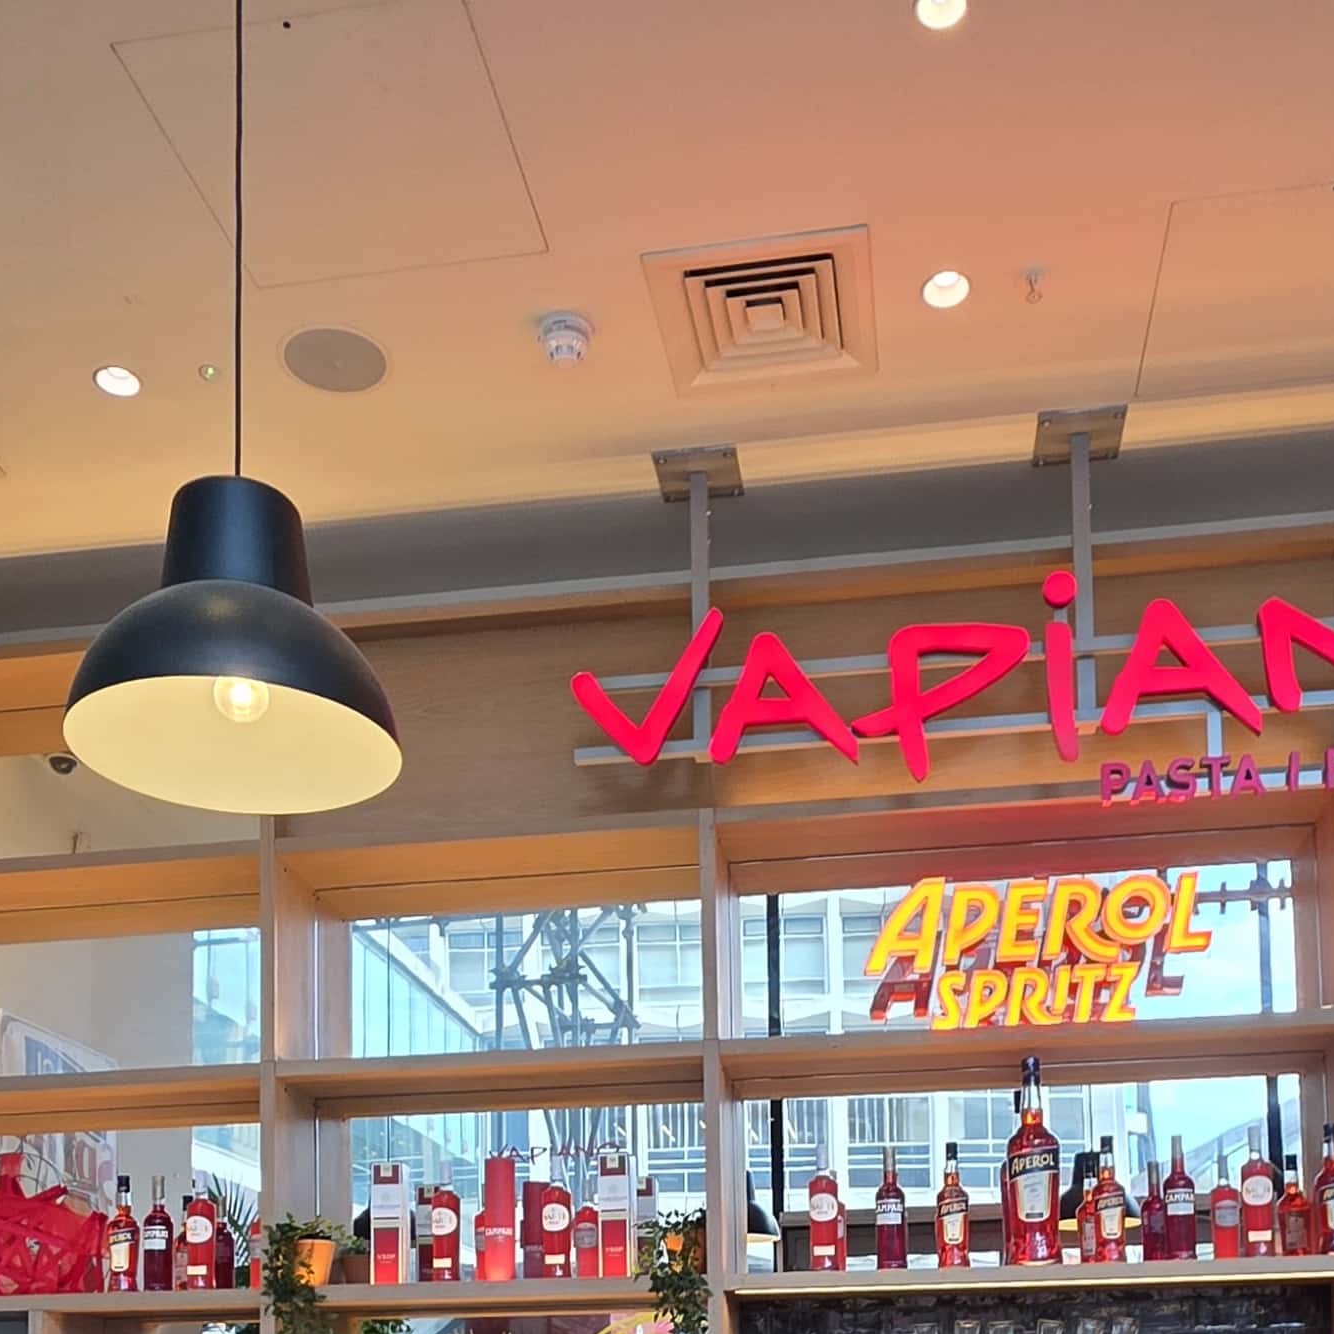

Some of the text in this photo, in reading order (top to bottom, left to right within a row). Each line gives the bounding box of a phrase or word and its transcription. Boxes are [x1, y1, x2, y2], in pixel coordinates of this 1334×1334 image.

[1100, 753, 1267, 804] PASTA
[864, 872, 1213, 977] APEROL
[930, 961, 1142, 1031] SPRITZ
[1011, 1153, 1055, 1176] APEROL
